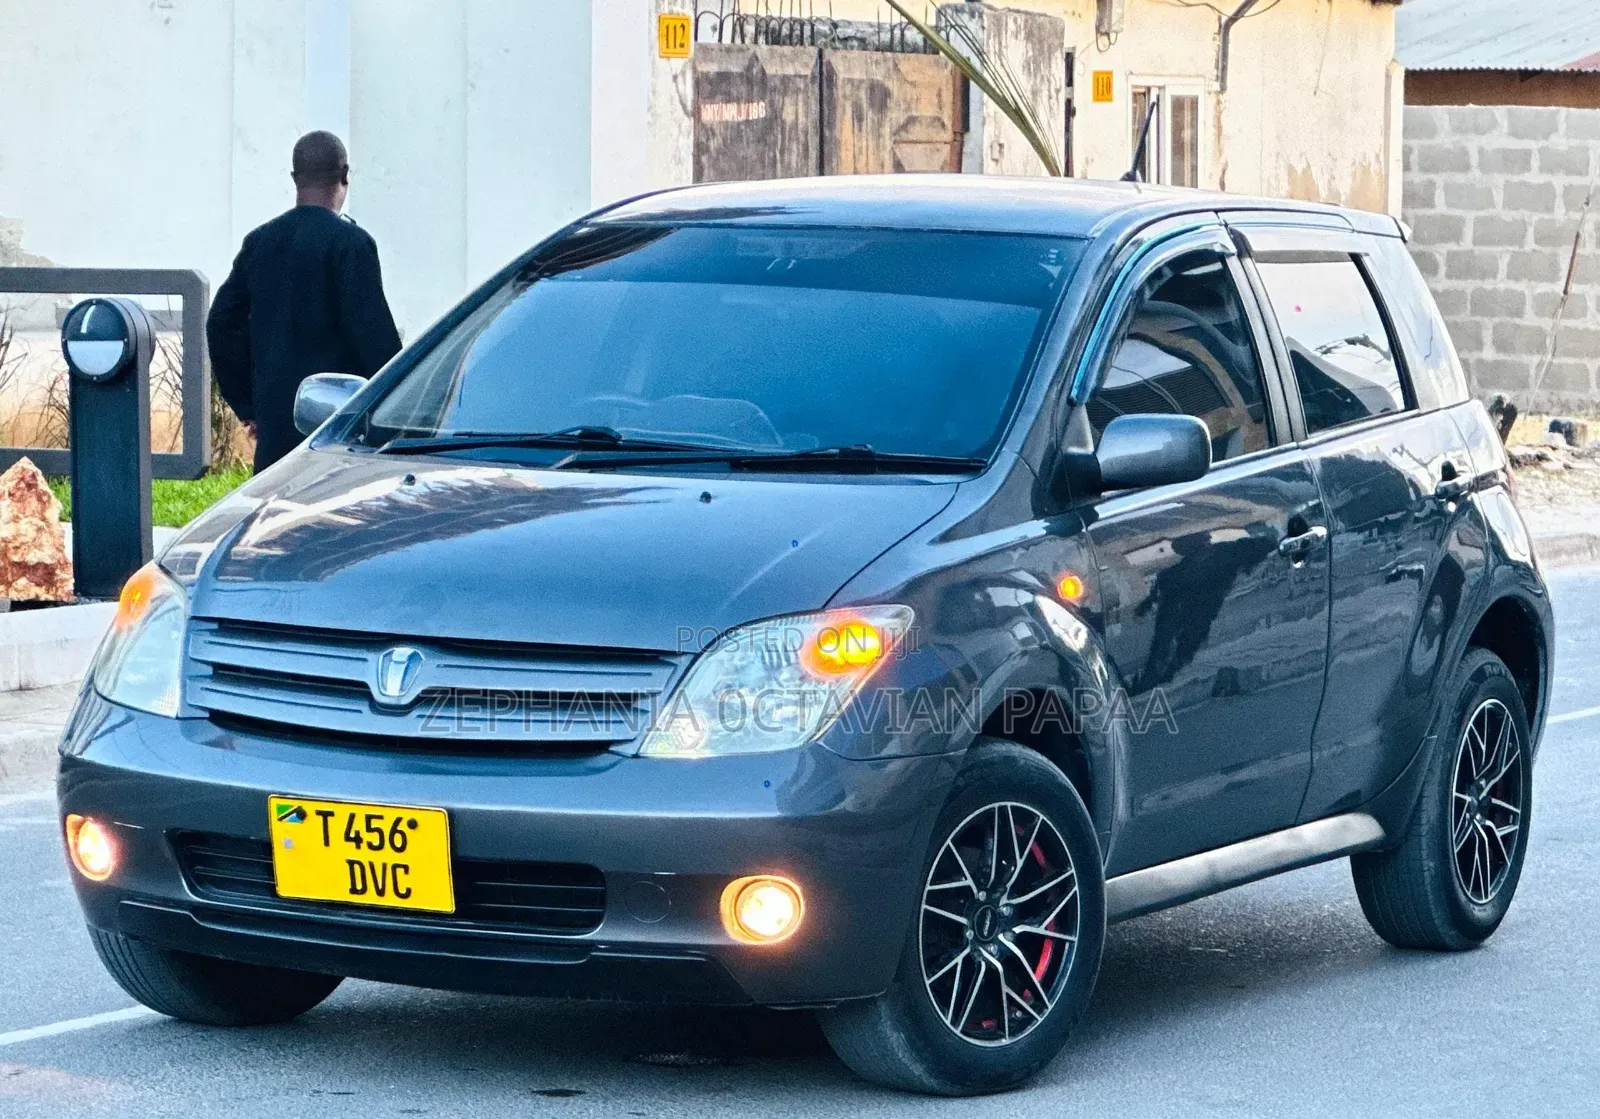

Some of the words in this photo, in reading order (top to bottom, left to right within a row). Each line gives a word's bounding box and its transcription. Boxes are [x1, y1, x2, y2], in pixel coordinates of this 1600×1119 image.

[666, 23, 685, 49] 112
[1096, 76, 1111, 96] 110
[315, 809, 335, 847] T
[343, 812, 408, 853] 456
[345, 858, 412, 899] DVC
